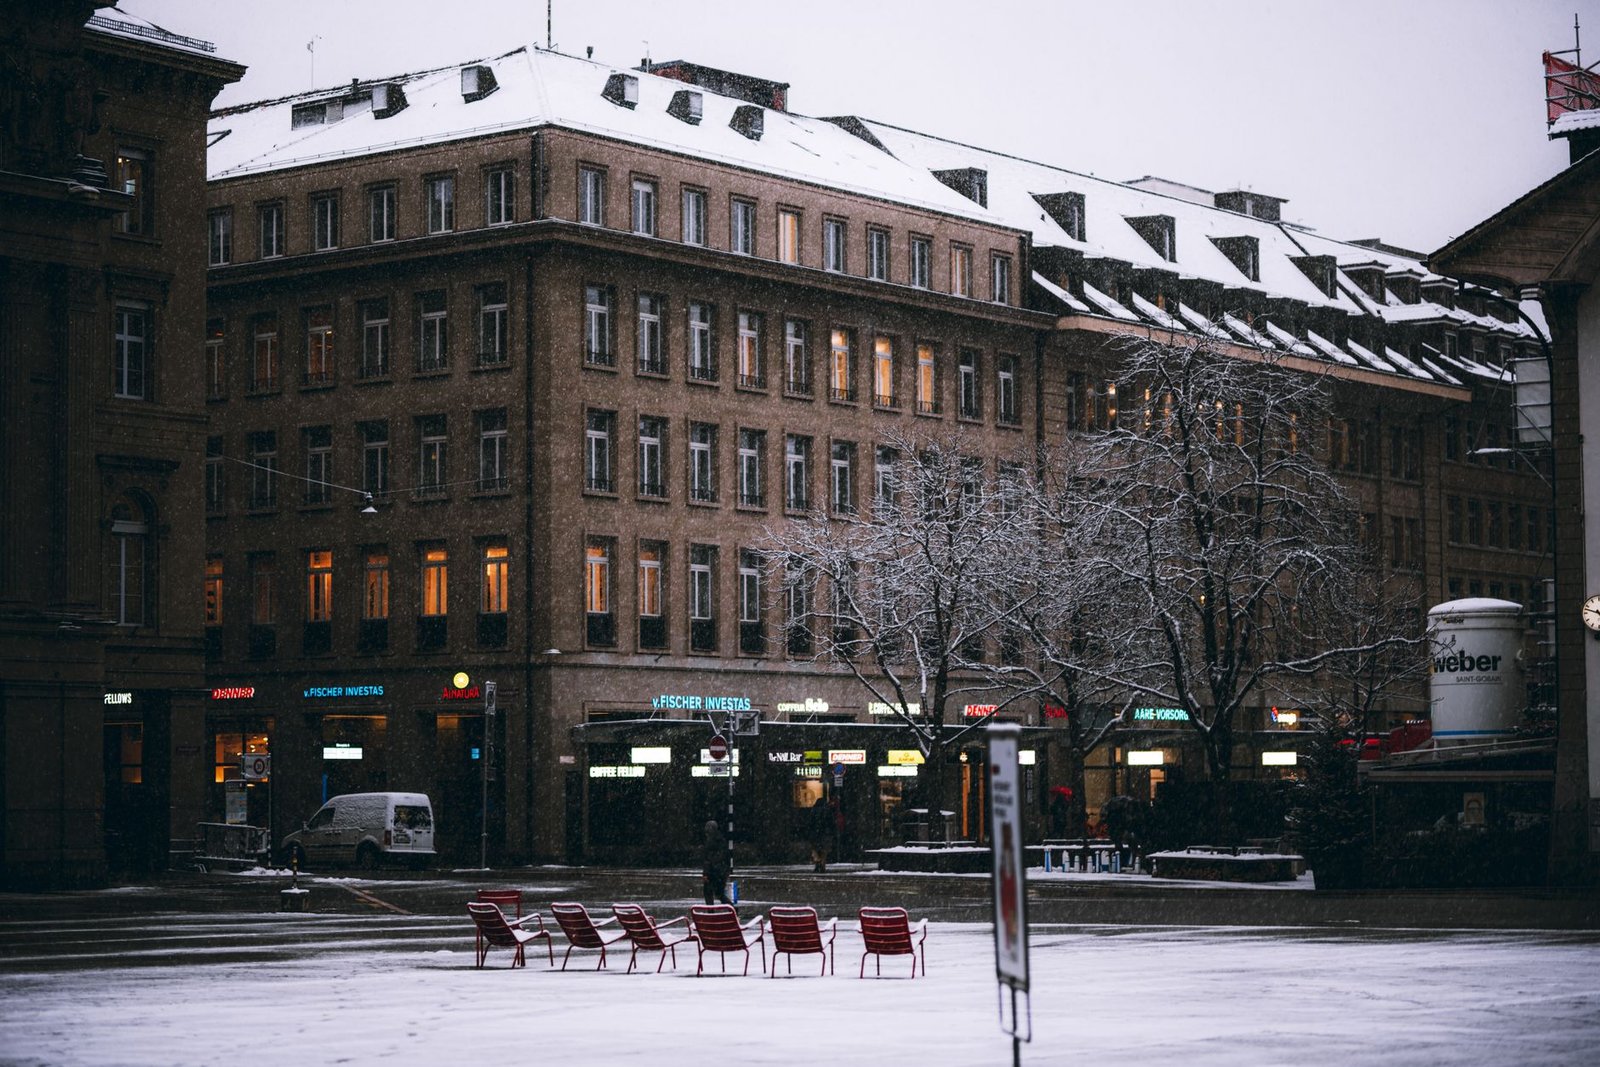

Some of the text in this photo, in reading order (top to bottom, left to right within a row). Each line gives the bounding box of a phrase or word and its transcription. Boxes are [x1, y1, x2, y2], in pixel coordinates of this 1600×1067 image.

[1433, 650, 1502, 673] weber
[1456, 675, 1502, 683] SAINT-GOBAIN
[104, 692, 132, 704] FELLOWS
[212, 687, 255, 700] DENNER
[304, 685, 384, 698] v.FISCHER INVESTAS
[652, 695, 751, 710] v.FISCHER INVESTAS
[832, 753, 863, 761] DENNER
